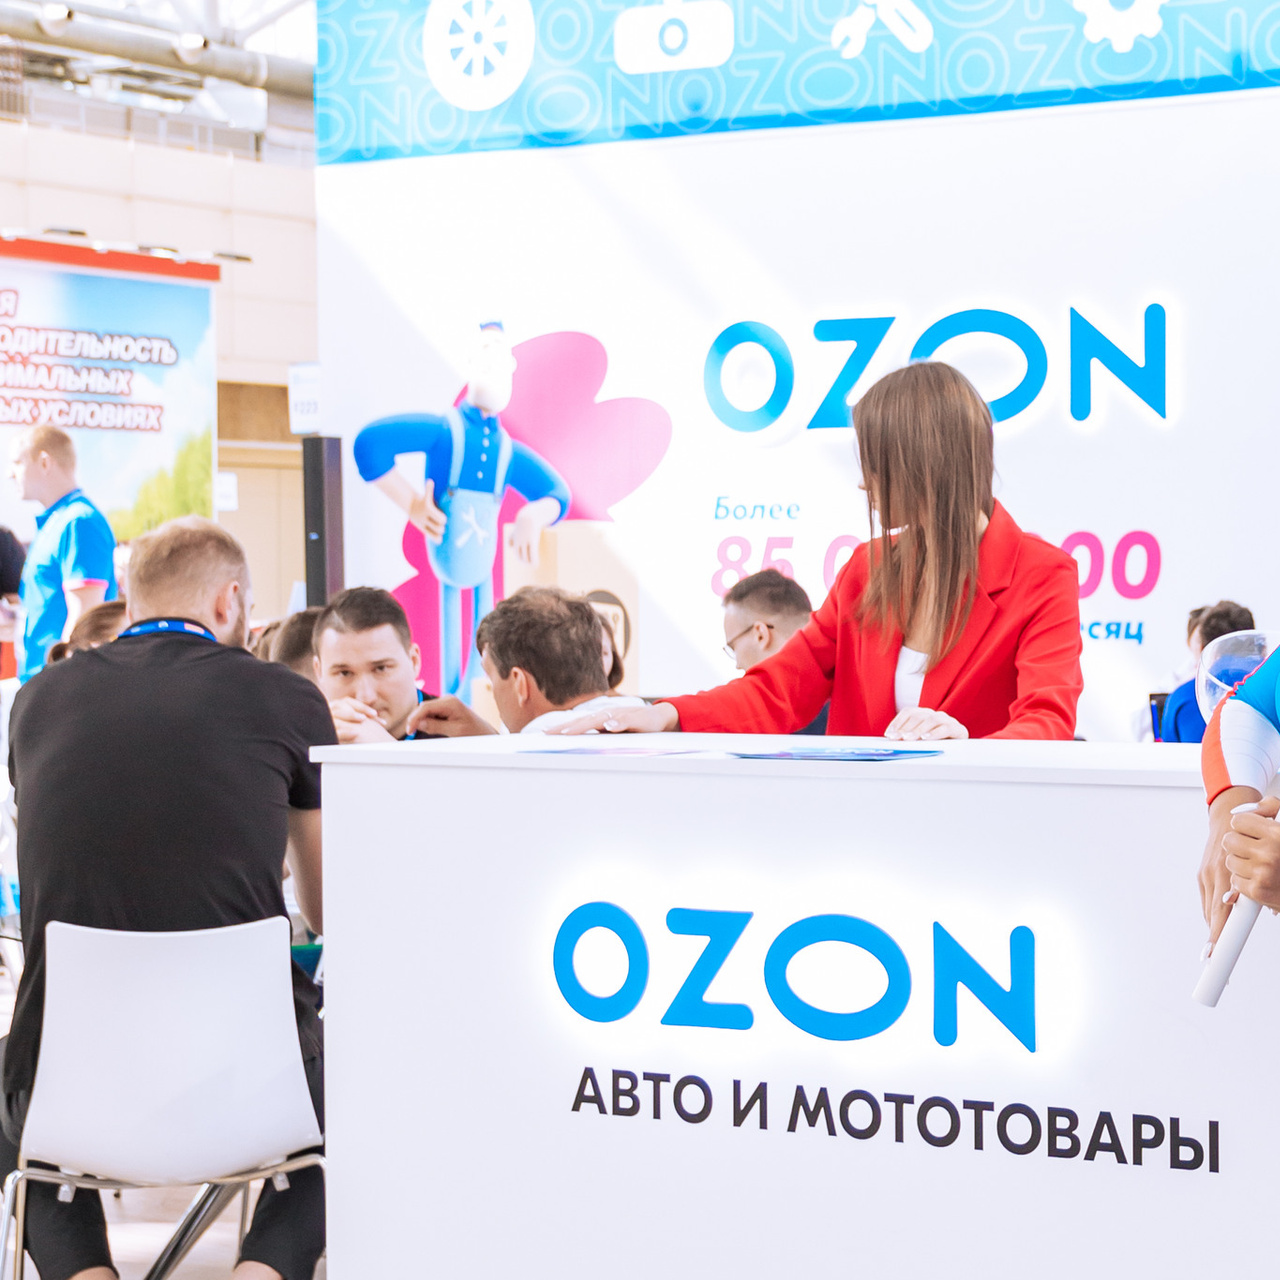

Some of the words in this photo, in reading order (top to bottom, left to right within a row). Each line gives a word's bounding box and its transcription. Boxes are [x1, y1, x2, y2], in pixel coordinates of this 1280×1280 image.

[704, 303, 1166, 433] OZON
[37, 398, 163, 431] УСЛОВИЯХ
[714, 496, 801, 520] Более
[1080, 622, 1143, 646] сяц
[553, 901, 1036, 1053] OZON
[571, 1066, 713, 1124] АВТО
[732, 1079, 768, 1130] И
[787, 1084, 1220, 1173] МОТОТОВАРЫ
